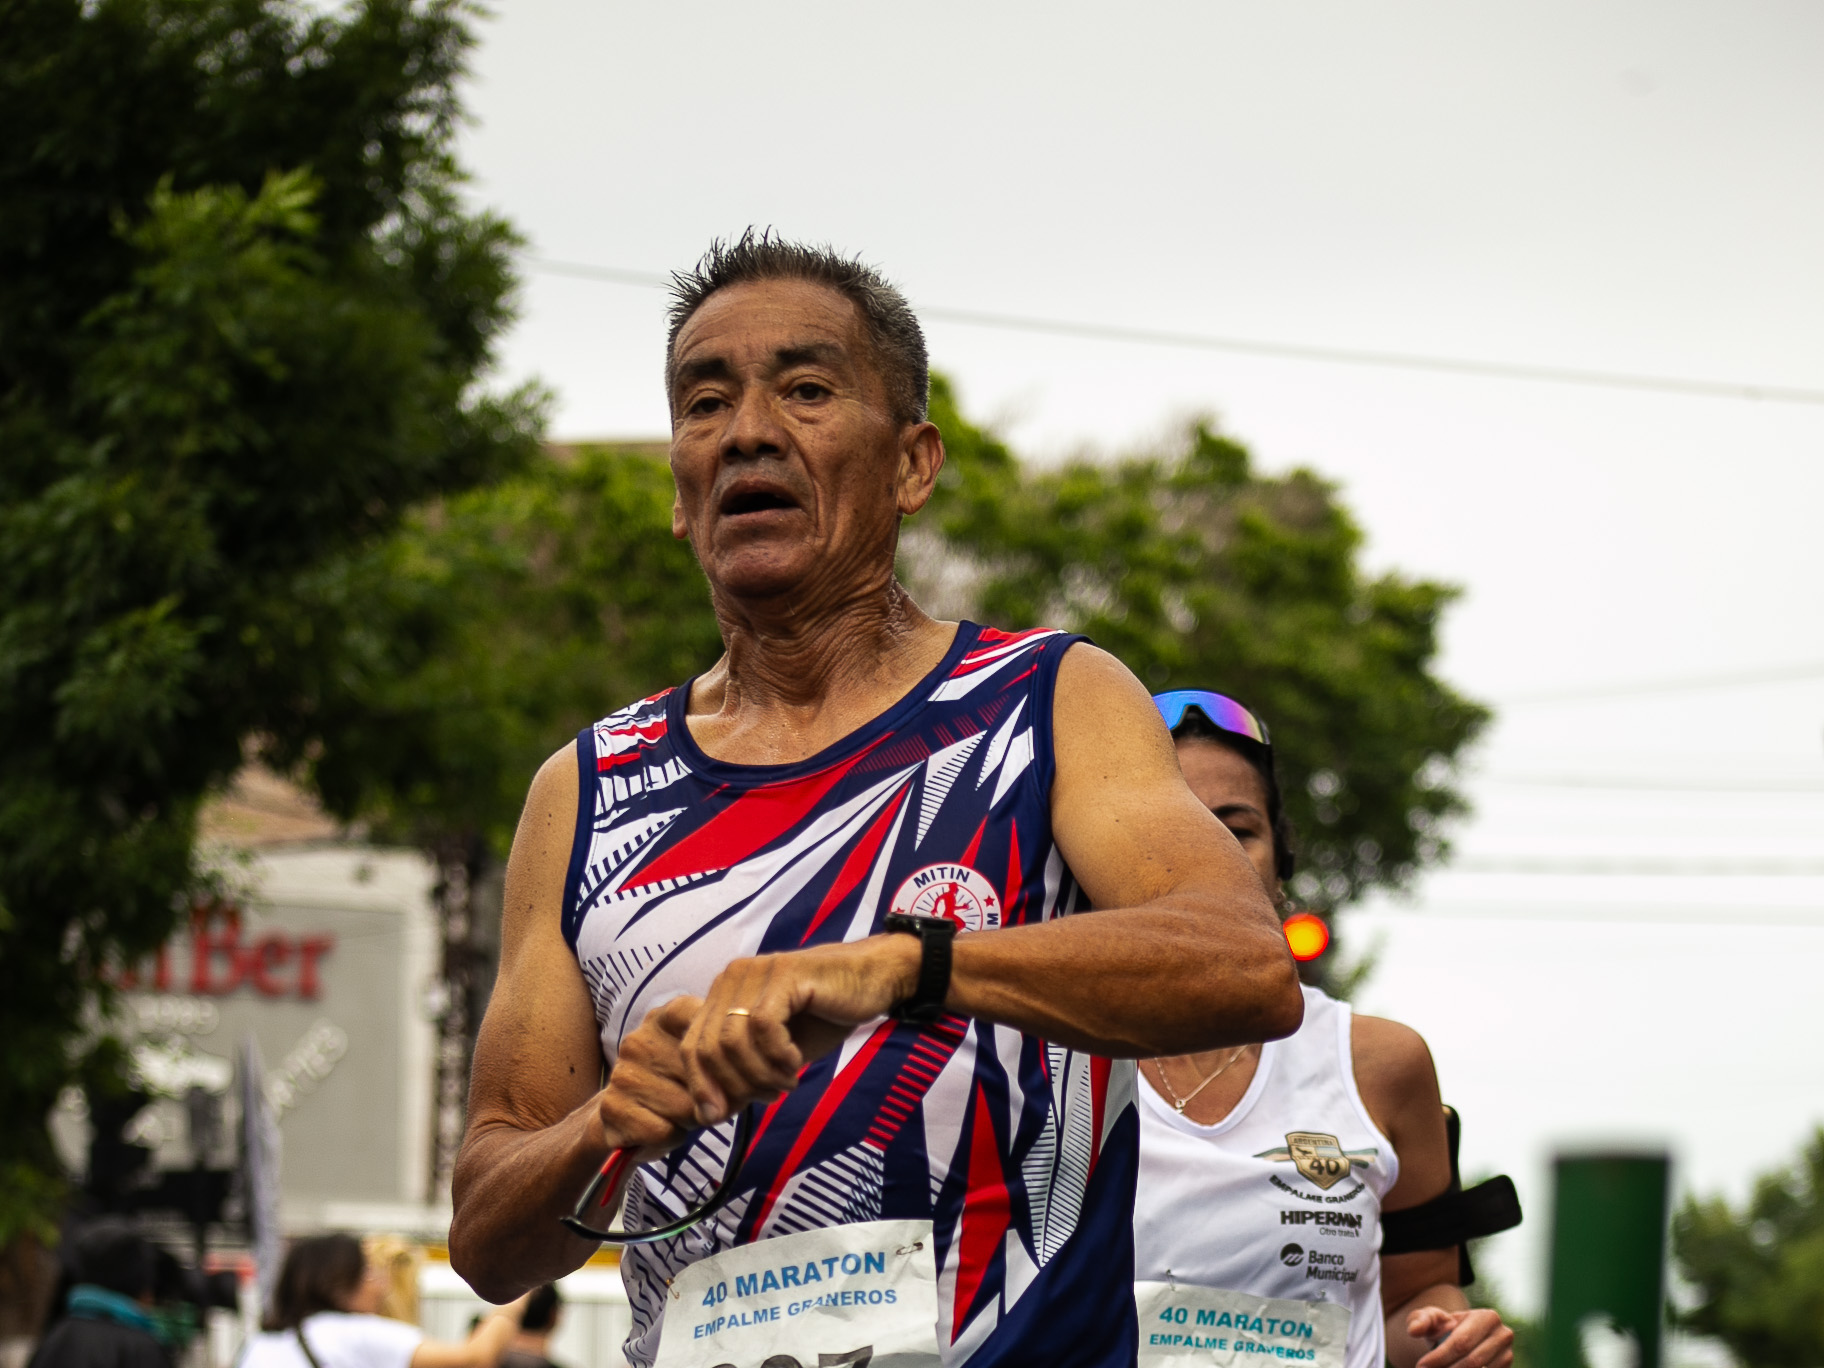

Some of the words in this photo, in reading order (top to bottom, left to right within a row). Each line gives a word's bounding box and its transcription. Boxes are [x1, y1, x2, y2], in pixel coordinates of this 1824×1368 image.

[913, 867, 970, 889] MITIN
[1309, 1159, 1340, 1176] 40
[1308, 1250, 1344, 1266] Banco
[702, 1281, 728, 1308] 40
[735, 1251, 886, 1298] MARATON
[1305, 1265, 1358, 1284] Municipal
[693, 1306, 781, 1340] EMPALME
[1159, 1306, 1188, 1325] 40
[1196, 1309, 1313, 1339] MARATON
[1149, 1334, 1227, 1351] EMPALME
